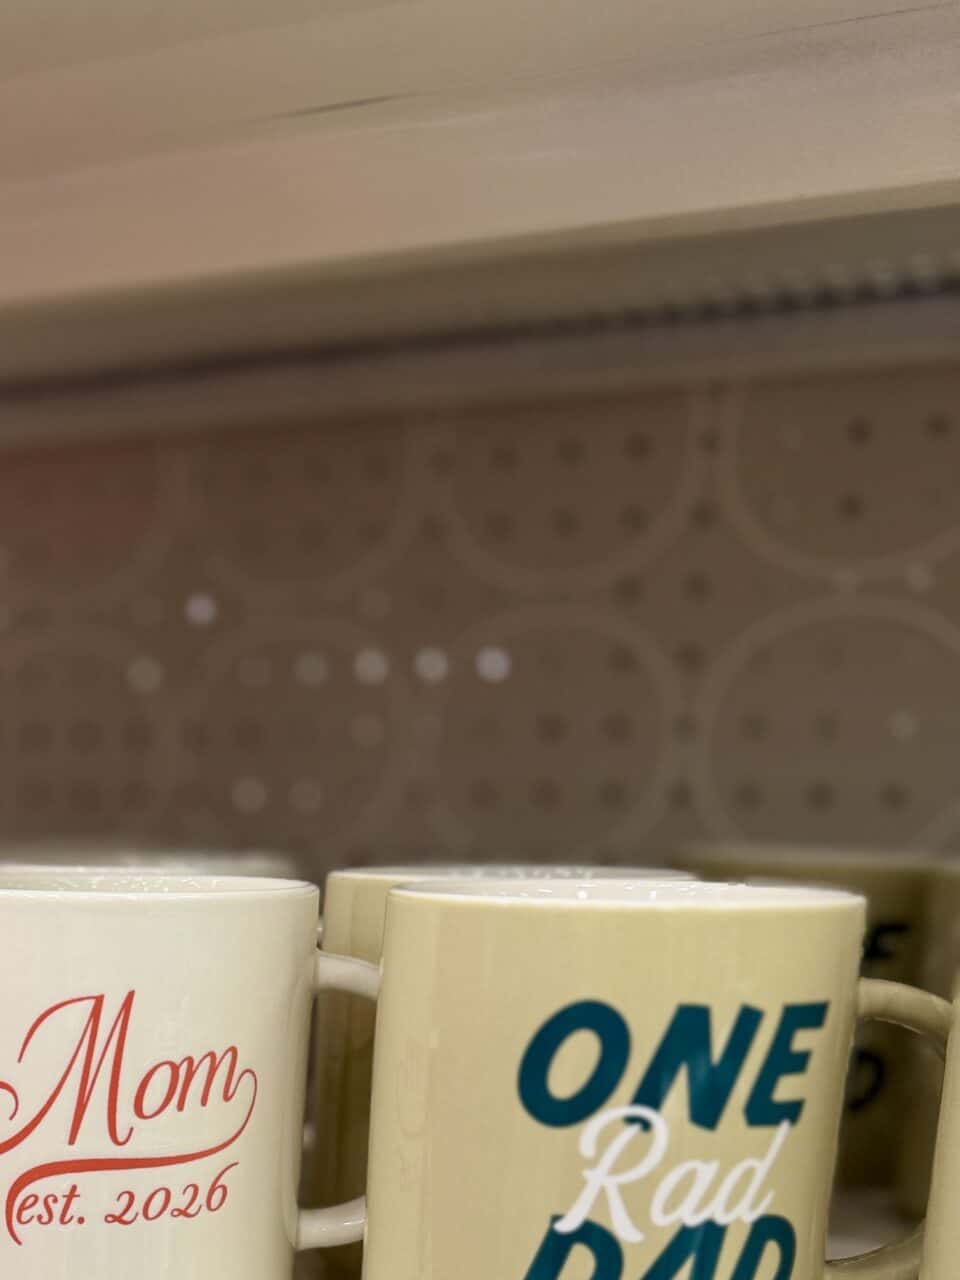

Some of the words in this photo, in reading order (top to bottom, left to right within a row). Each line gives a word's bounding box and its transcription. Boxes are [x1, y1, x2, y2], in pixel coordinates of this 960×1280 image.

[516, 998, 829, 1133] ONE
[15, 1183, 86, 1226] est.
[103, 1161, 239, 1226] 2026
[553, 1105, 793, 1243] Rad
